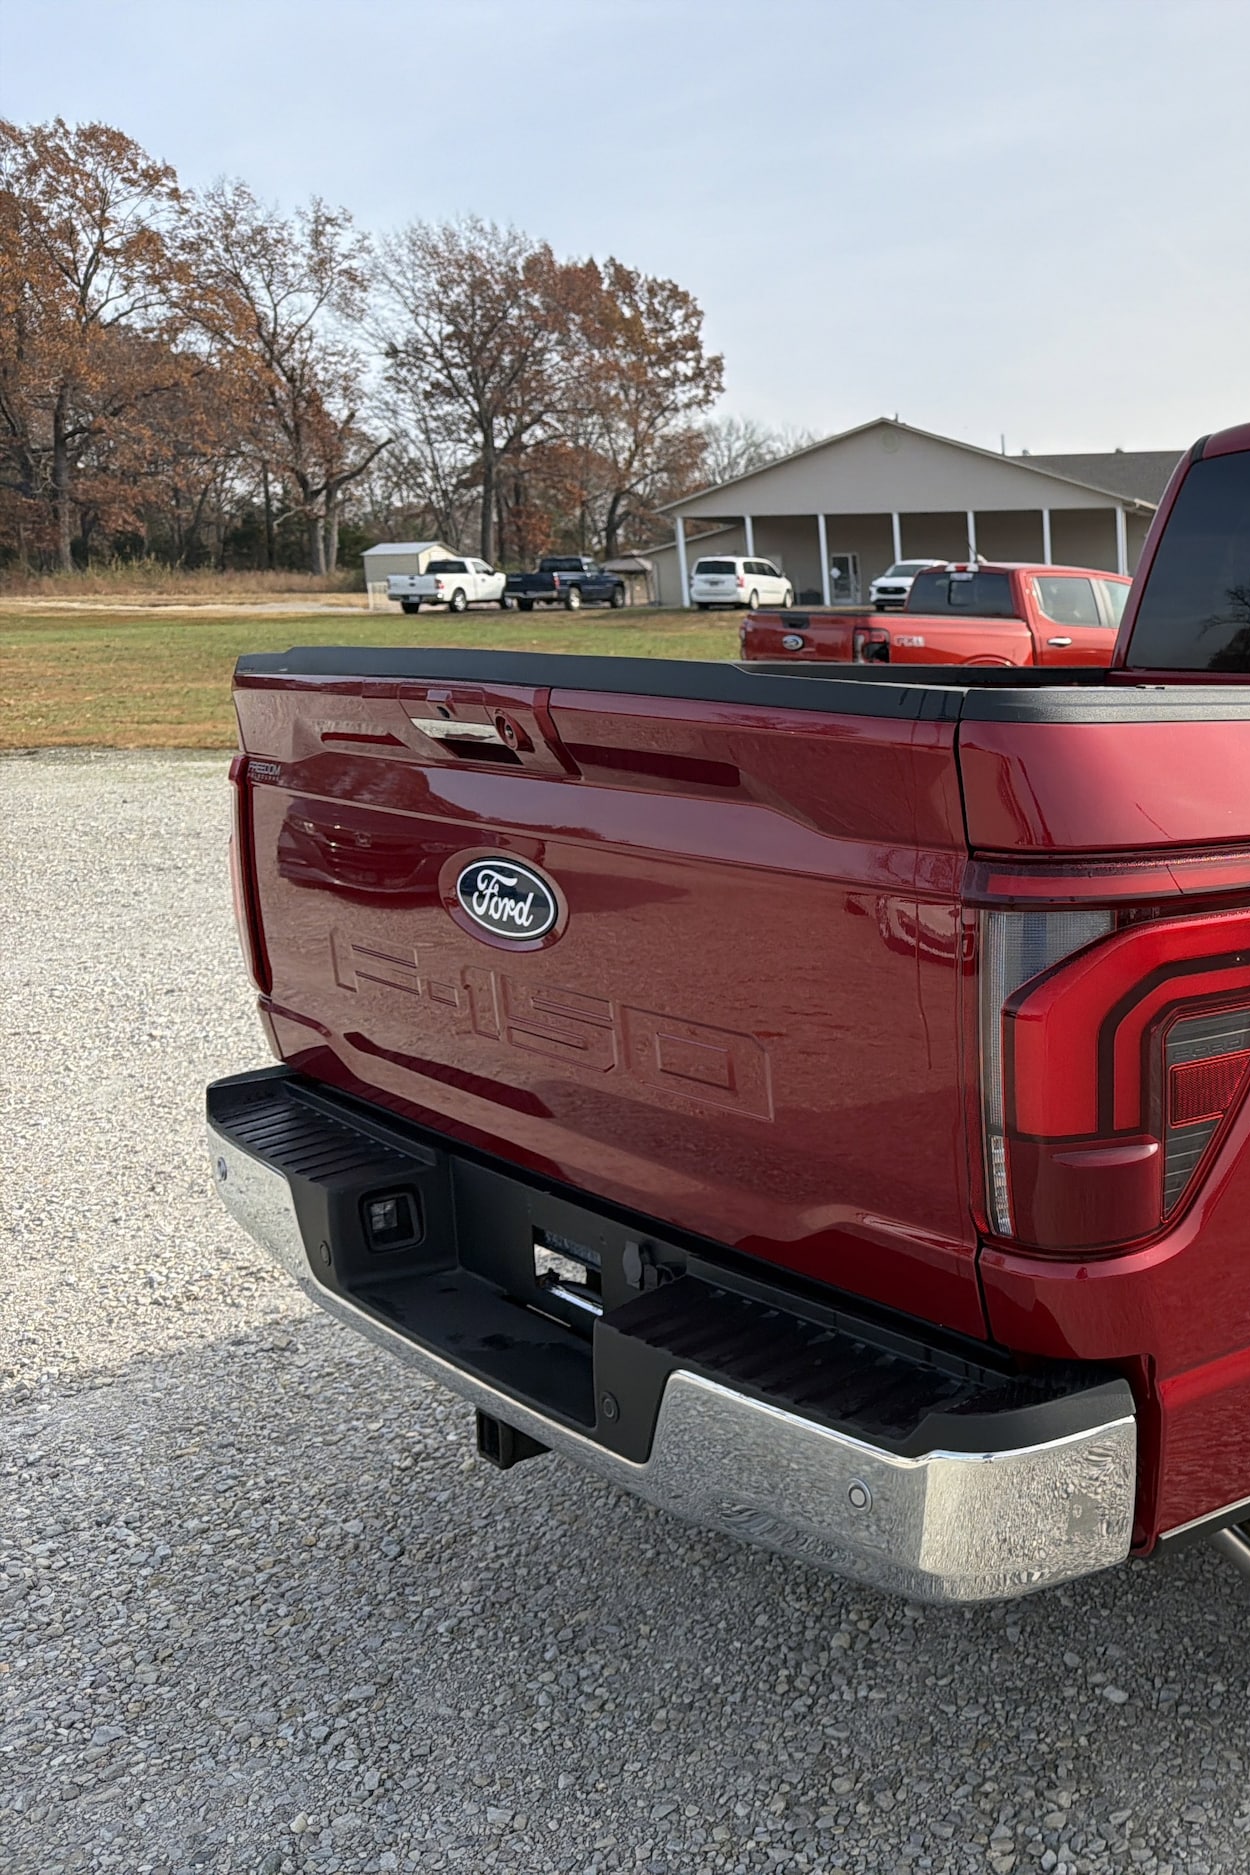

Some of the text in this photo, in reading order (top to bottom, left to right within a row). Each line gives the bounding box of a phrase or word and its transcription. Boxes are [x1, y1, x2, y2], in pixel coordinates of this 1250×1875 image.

[248, 761, 280, 775] FREEDOM
[472, 869, 534, 927] Ford
[331, 928, 774, 1122] F-150
